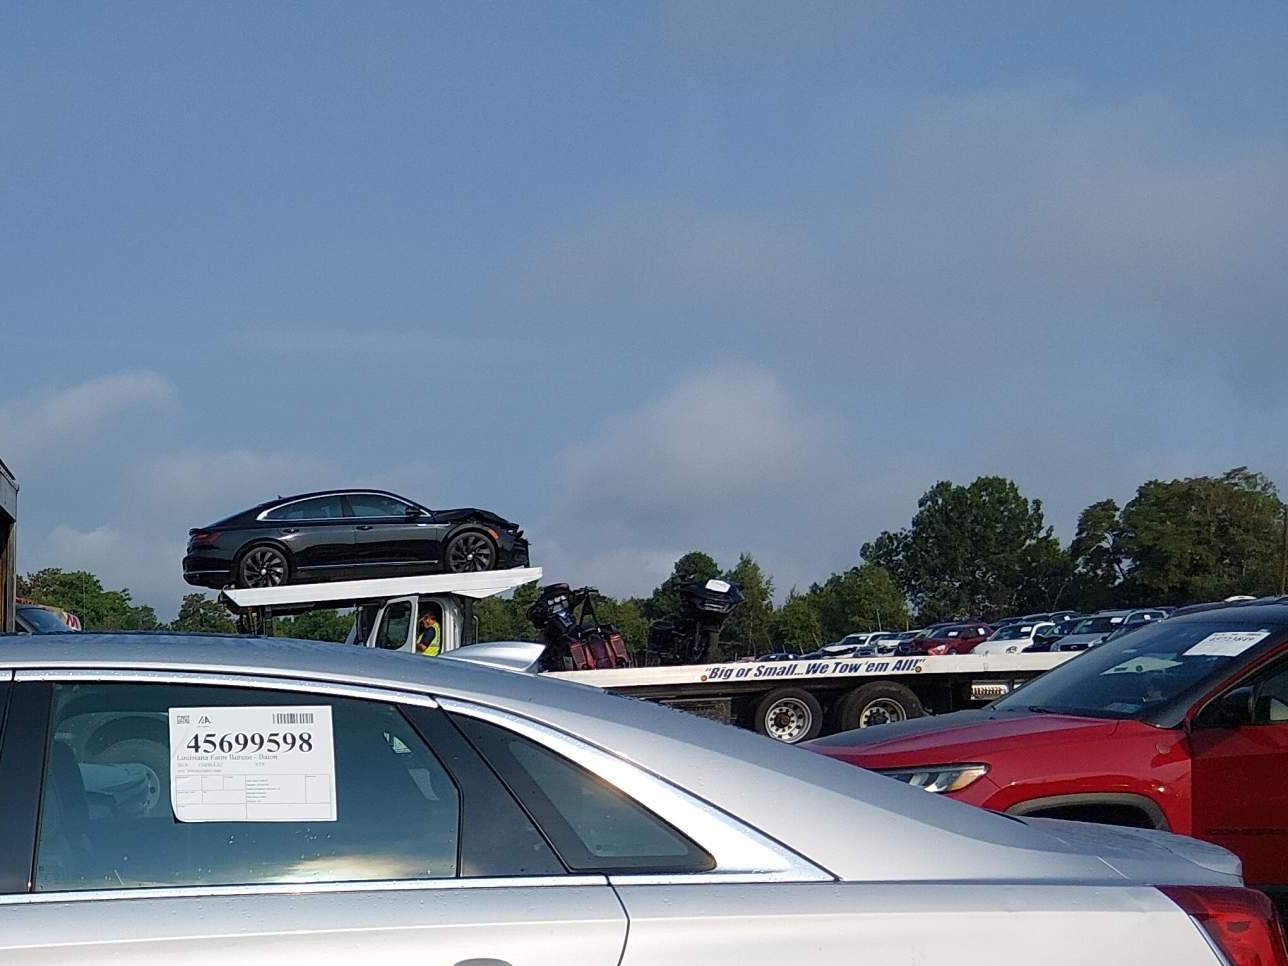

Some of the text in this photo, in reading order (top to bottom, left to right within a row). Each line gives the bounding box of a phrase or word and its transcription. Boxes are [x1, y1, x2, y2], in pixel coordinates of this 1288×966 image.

[735, 668, 753, 678] or
[831, 662, 862, 674] Tow
[186, 732, 313, 754] 45699598
